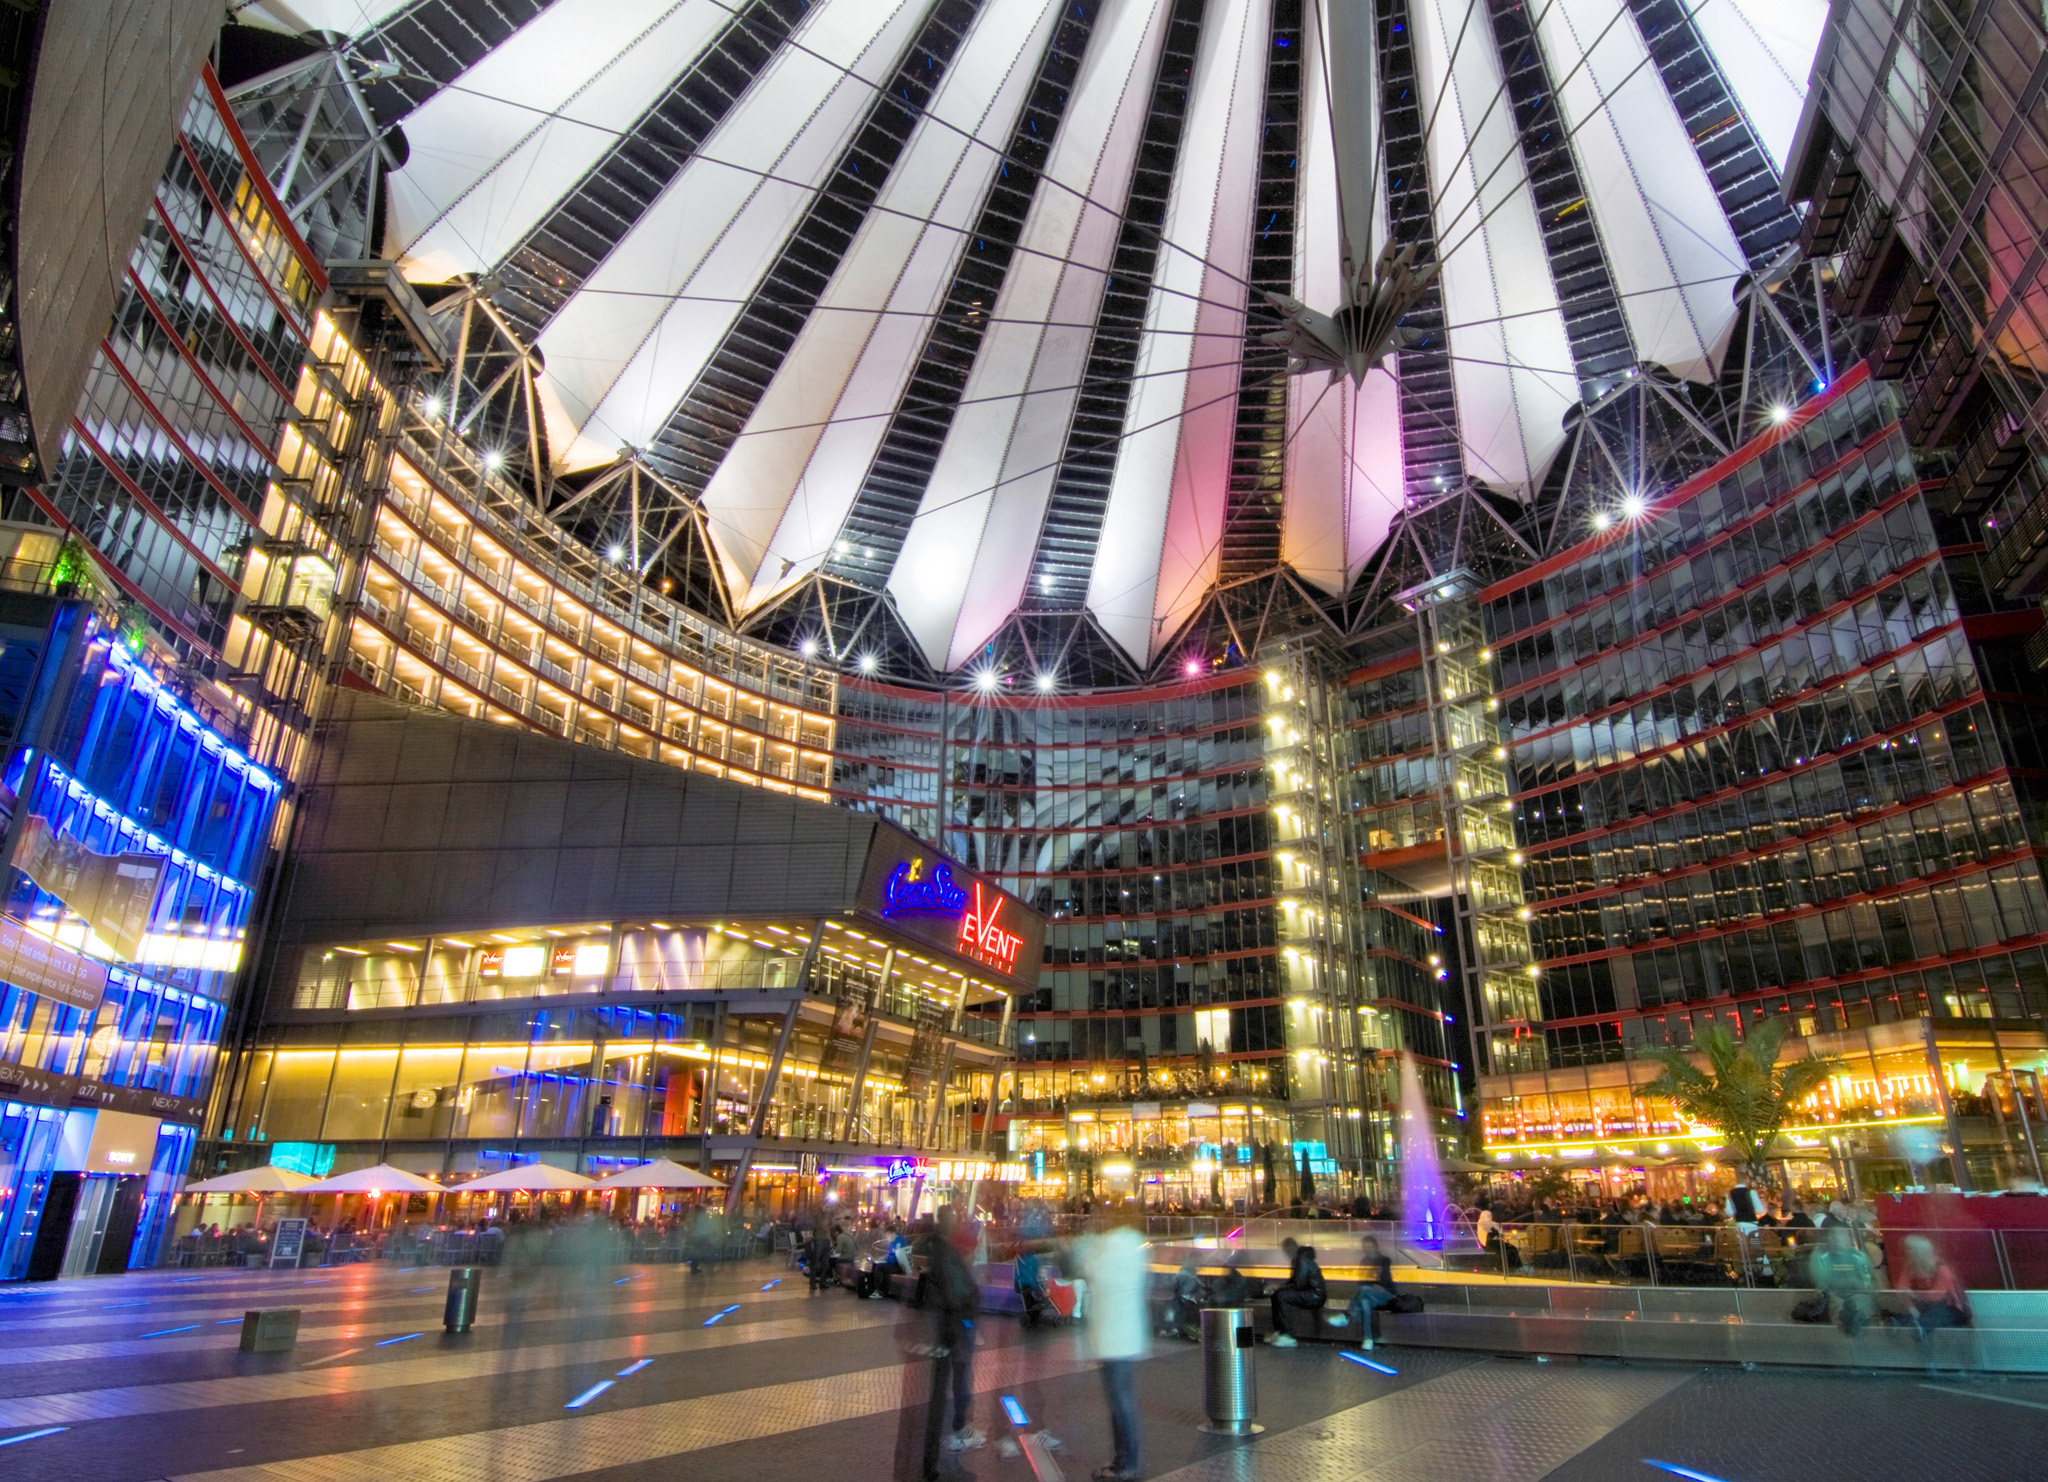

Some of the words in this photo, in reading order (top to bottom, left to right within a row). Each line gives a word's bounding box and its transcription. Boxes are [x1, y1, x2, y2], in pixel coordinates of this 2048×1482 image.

[962, 881, 1023, 962] EVENT
[0, 1065, 25, 1082] EX-7
[151, 1096, 181, 1110] NEX-7
